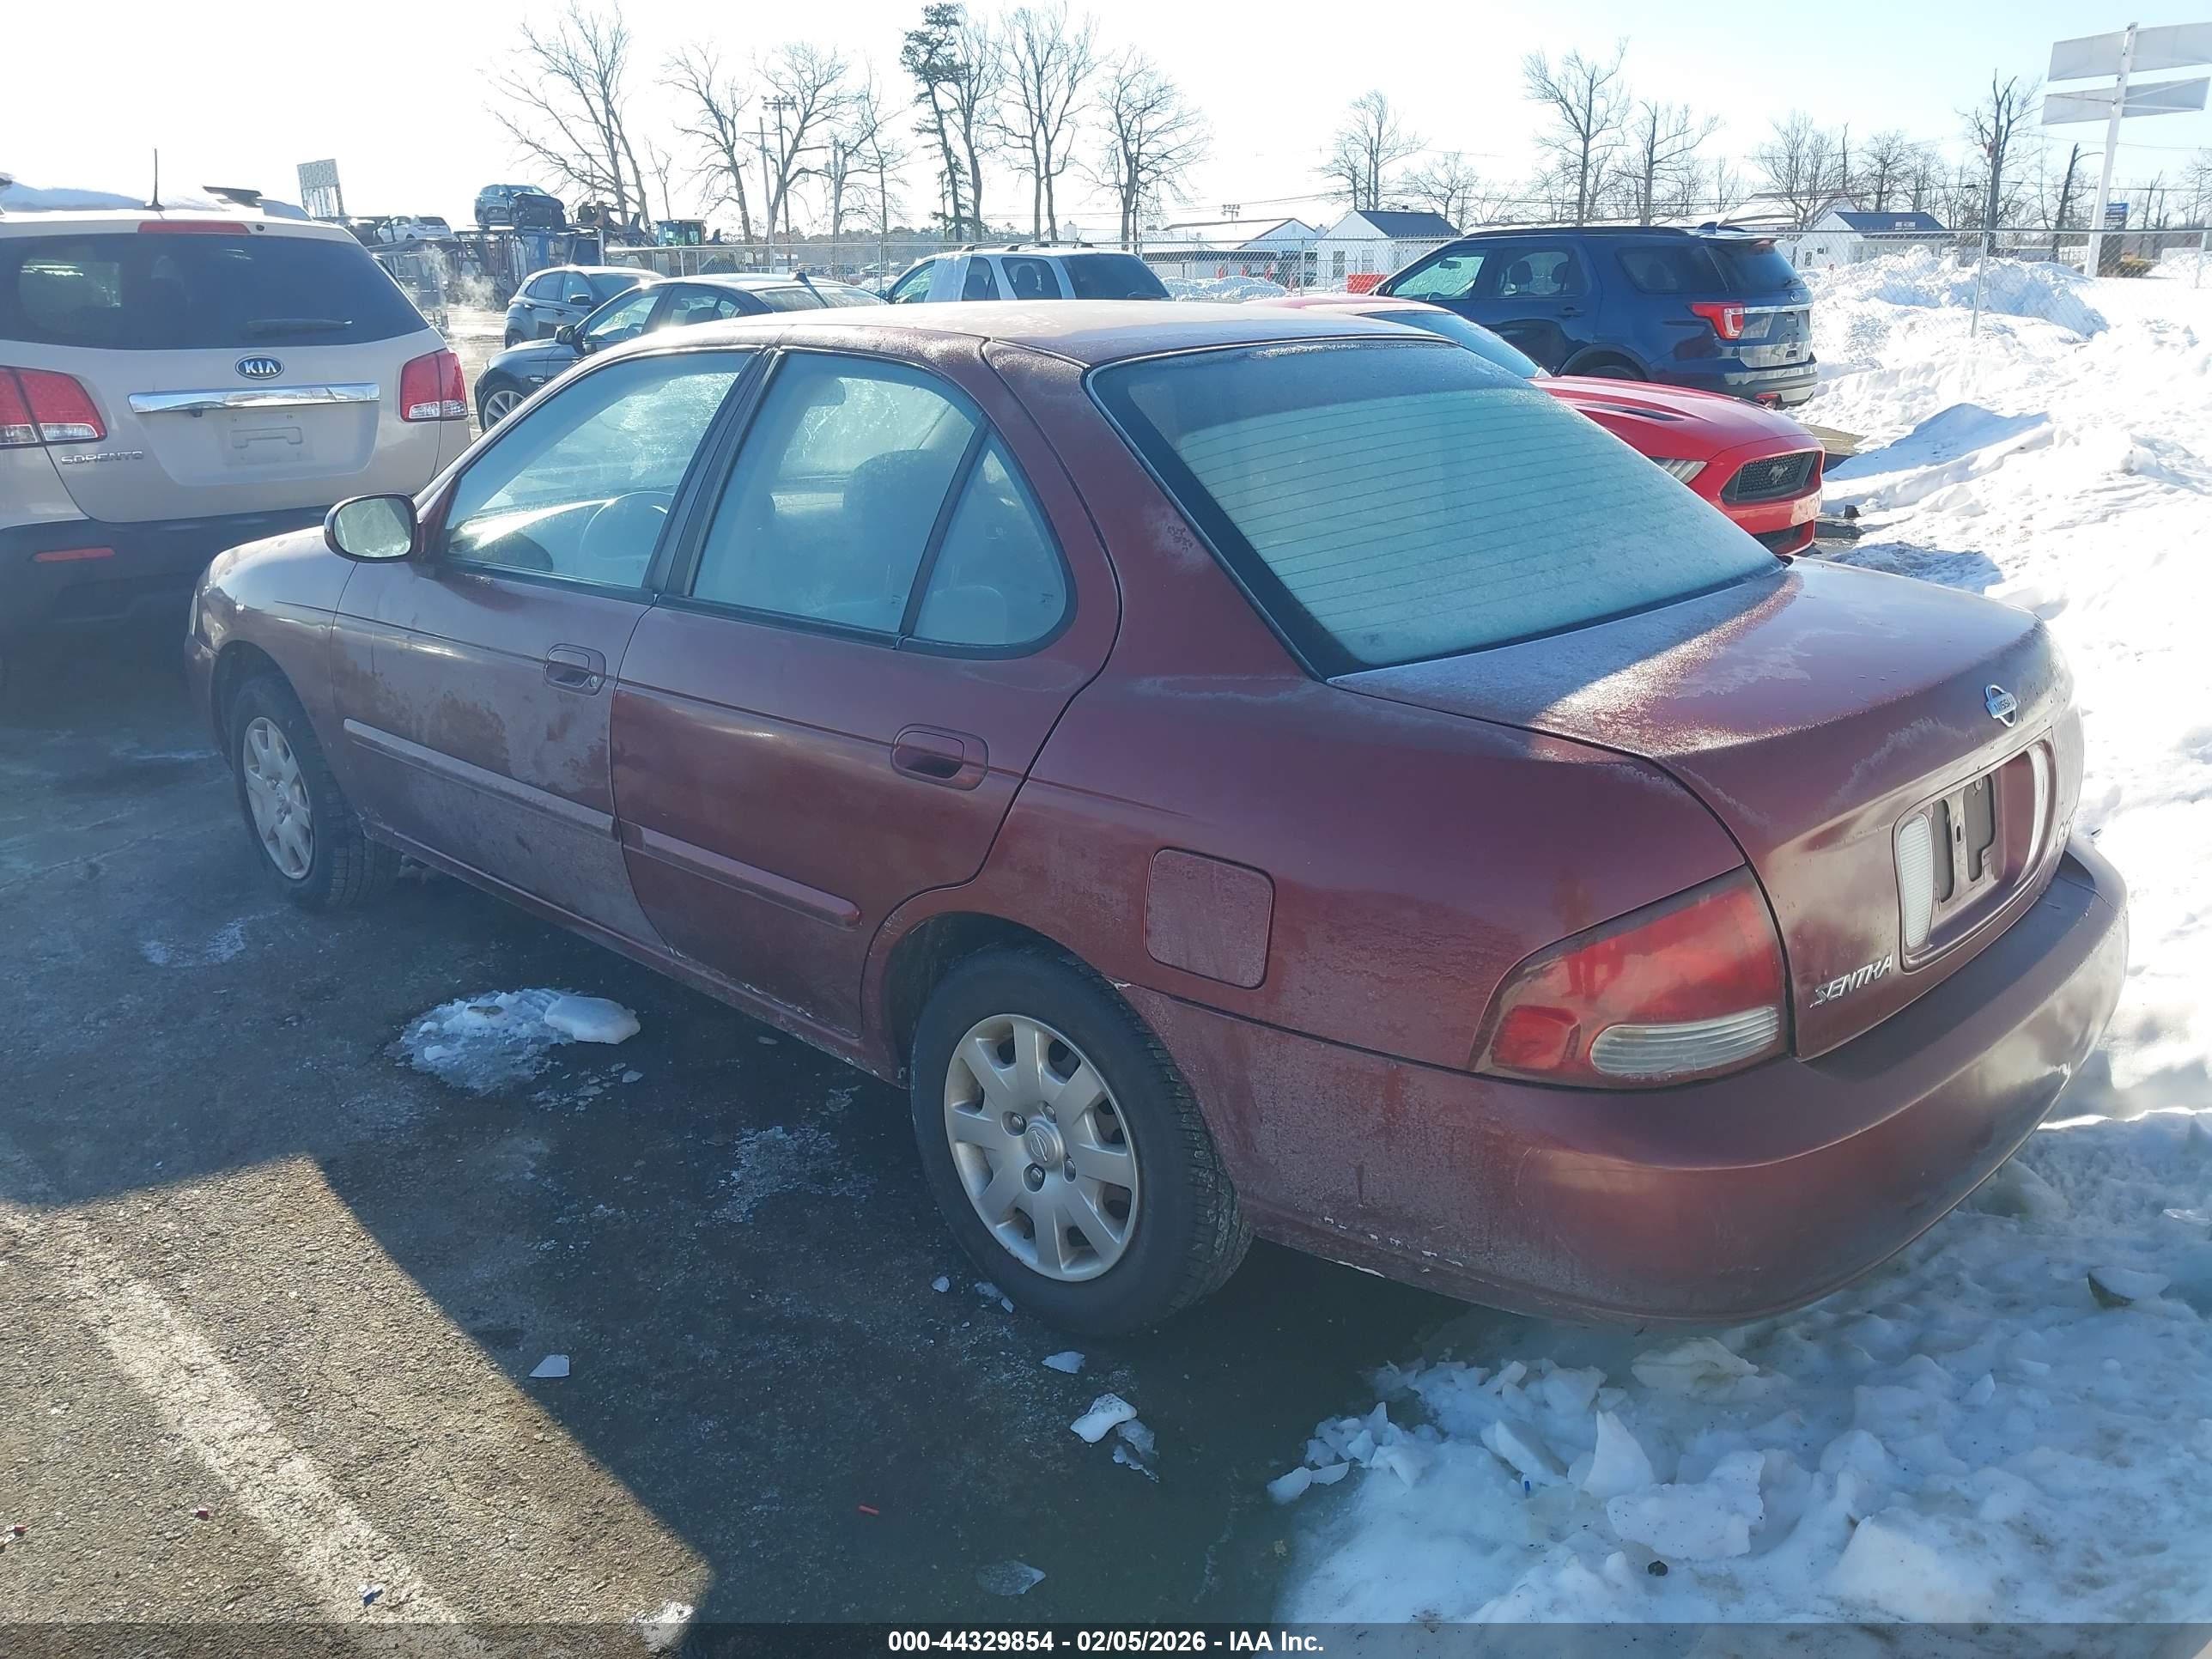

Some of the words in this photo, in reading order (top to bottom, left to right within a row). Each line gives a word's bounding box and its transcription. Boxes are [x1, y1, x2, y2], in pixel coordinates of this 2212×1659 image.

[243, 361, 277, 374] KIA
[61, 450, 144, 465] SORENTO
[1809, 955, 1893, 1009] SENTRA
